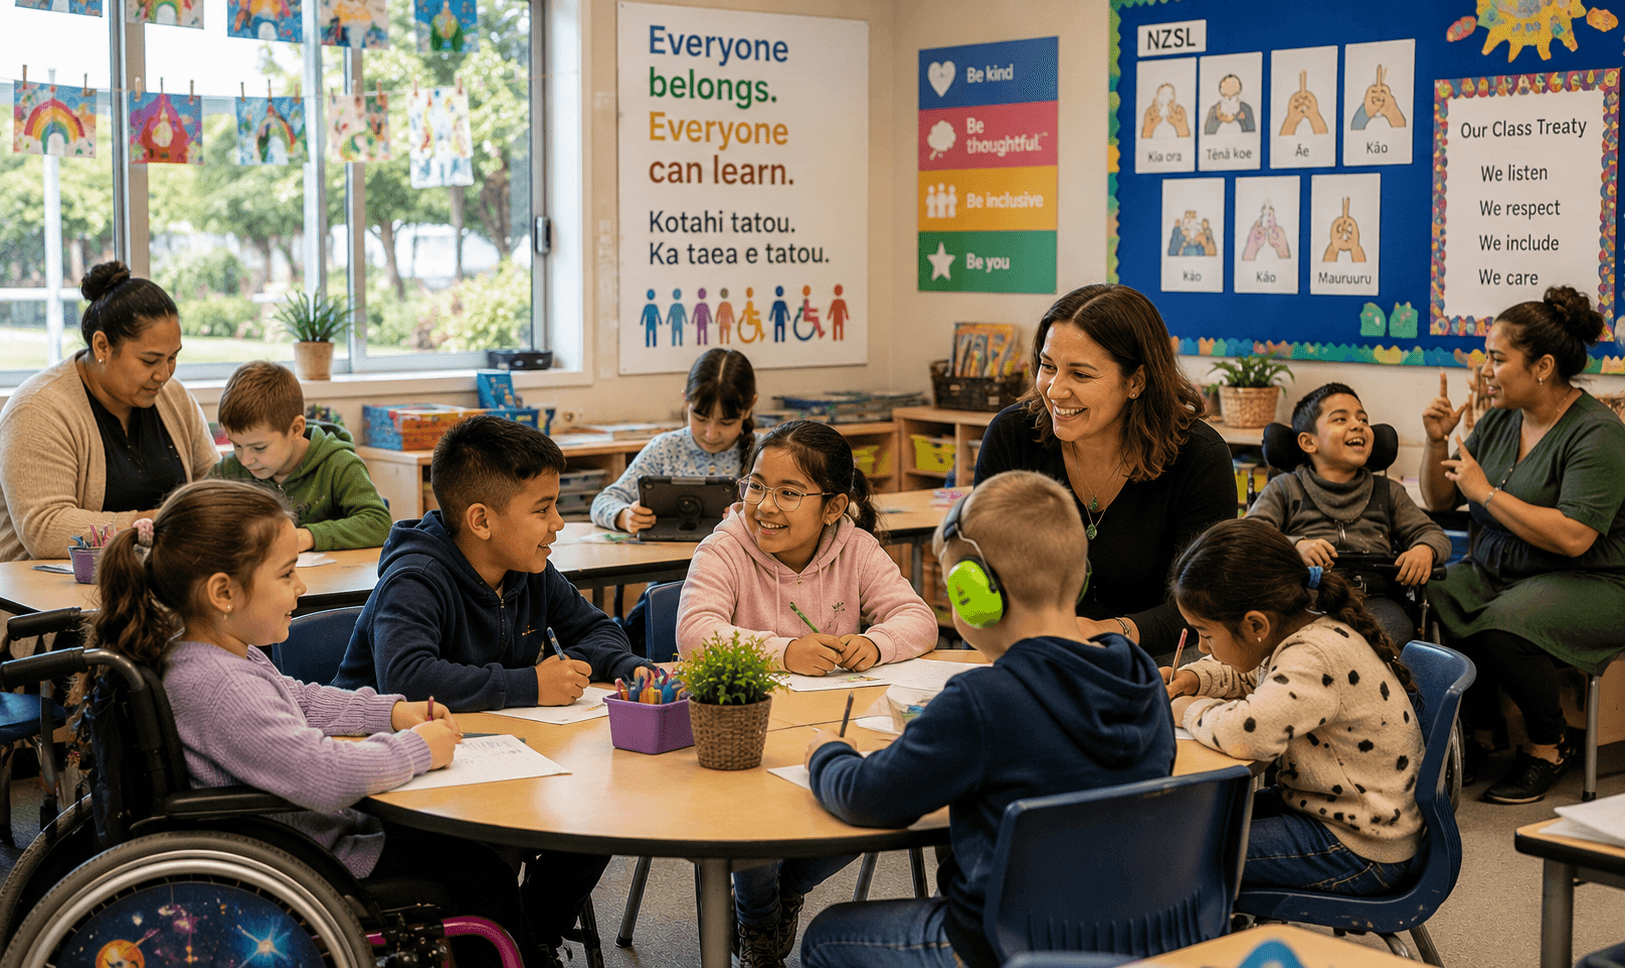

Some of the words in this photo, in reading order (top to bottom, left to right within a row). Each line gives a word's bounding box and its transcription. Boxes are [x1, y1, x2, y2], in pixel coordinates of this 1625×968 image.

[650, 25, 788, 66] Everyone
[1147, 28, 1196, 51] NZSL
[966, 66, 985, 84] Be
[985, 63, 1014, 82] kind
[650, 67, 777, 109] belongs.
[650, 112, 788, 151] Everyone
[966, 117, 985, 134] Be
[1461, 123, 1488, 138] Our
[1493, 120, 1532, 137] Class
[1537, 118, 1587, 138] Treaty
[1166, 152, 1182, 162] ora
[1233, 147, 1253, 159] koe
[649, 161, 702, 183] can
[714, 155, 794, 185] learn.
[1481, 166, 1502, 182] We
[1508, 164, 1547, 181] listen
[966, 193, 985, 209] Be
[986, 191, 1044, 208] inclusive
[1480, 200, 1501, 216] We
[1507, 200, 1560, 219] respect
[650, 210, 723, 233] Kotahi
[731, 213, 795, 233] tatou.
[1479, 235, 1501, 250] We
[1507, 234, 1559, 251] include
[650, 242, 678, 265] Ka
[687, 244, 737, 264] taea
[746, 247, 758, 264] e
[766, 244, 829, 263] tatou.
[966, 253, 984, 270] Be
[985, 256, 1010, 273] you
[1318, 272, 1372, 285] Mauruuru
[1479, 269, 1501, 285] We
[1506, 273, 1538, 285] care
